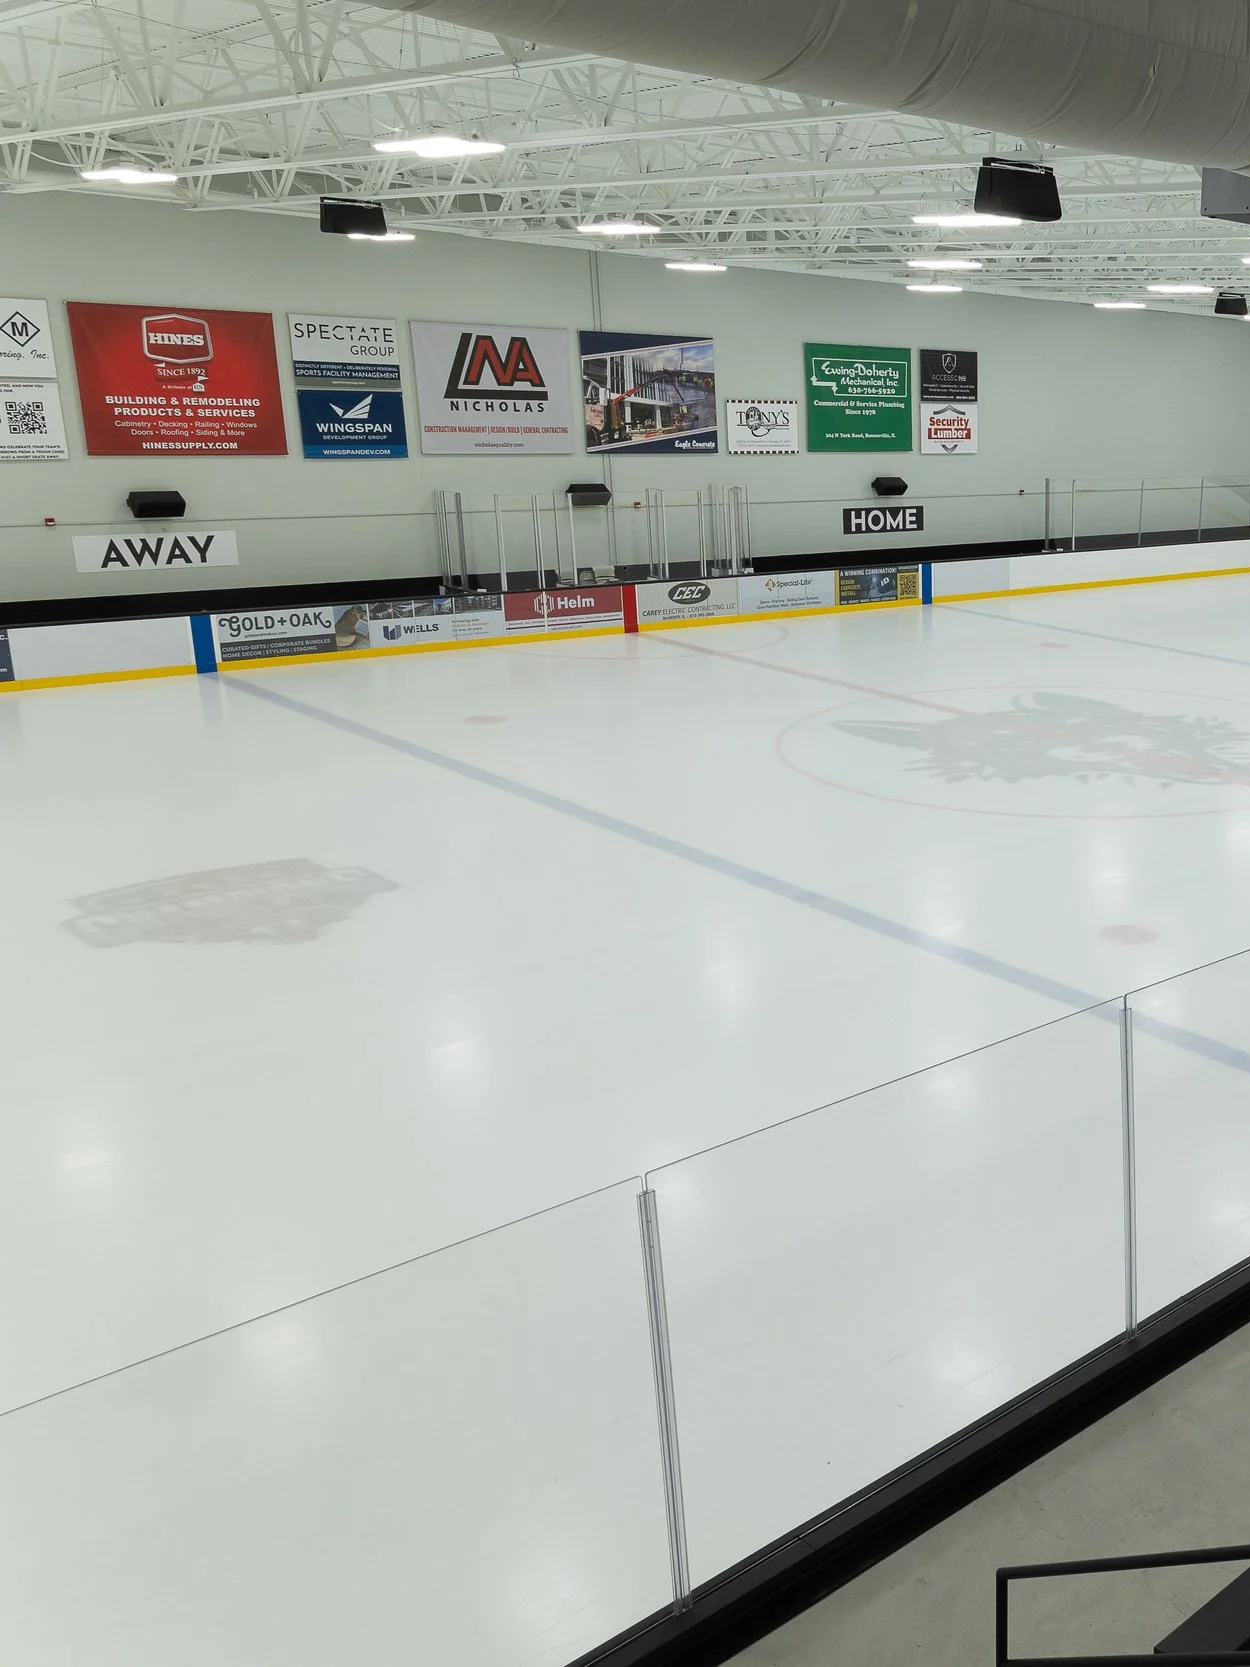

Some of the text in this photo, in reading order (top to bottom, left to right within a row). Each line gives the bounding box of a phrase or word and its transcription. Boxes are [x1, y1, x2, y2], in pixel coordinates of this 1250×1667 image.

[11, 322, 29, 336] M
[294, 322, 394, 342] SPECTATE
[148, 333, 204, 346] HINES
[350, 346, 394, 356] GROUP
[157, 368, 185, 376] SINCE
[821, 361, 898, 378] Ewing-Doherty
[840, 377, 884, 386] Mechanical,
[106, 396, 260, 406] BUILDING & REMODELING
[450, 400, 544, 412] NICHOLAS
[114, 408, 256, 417] PRODUCTS & SERVICES
[115, 420, 151, 428] Cabinetry
[159, 421, 188, 429] Decking
[195, 421, 220, 429] Railing
[929, 416, 970, 428] Security
[161, 429, 189, 437] Roofing
[316, 424, 392, 432] WINGSPAN
[932, 428, 968, 438] Lumber
[674, 440, 690, 449] Eagle
[851, 508, 918, 532] HOME
[100, 535, 214, 568] AWAY
[672, 585, 706, 600] CEC
[557, 595, 595, 610] Helm
[218, 616, 275, 638] GOLD
[290, 612, 332, 628] OAK
[403, 624, 439, 634] WELLS
[270, 640, 304, 648] CORPORATE
